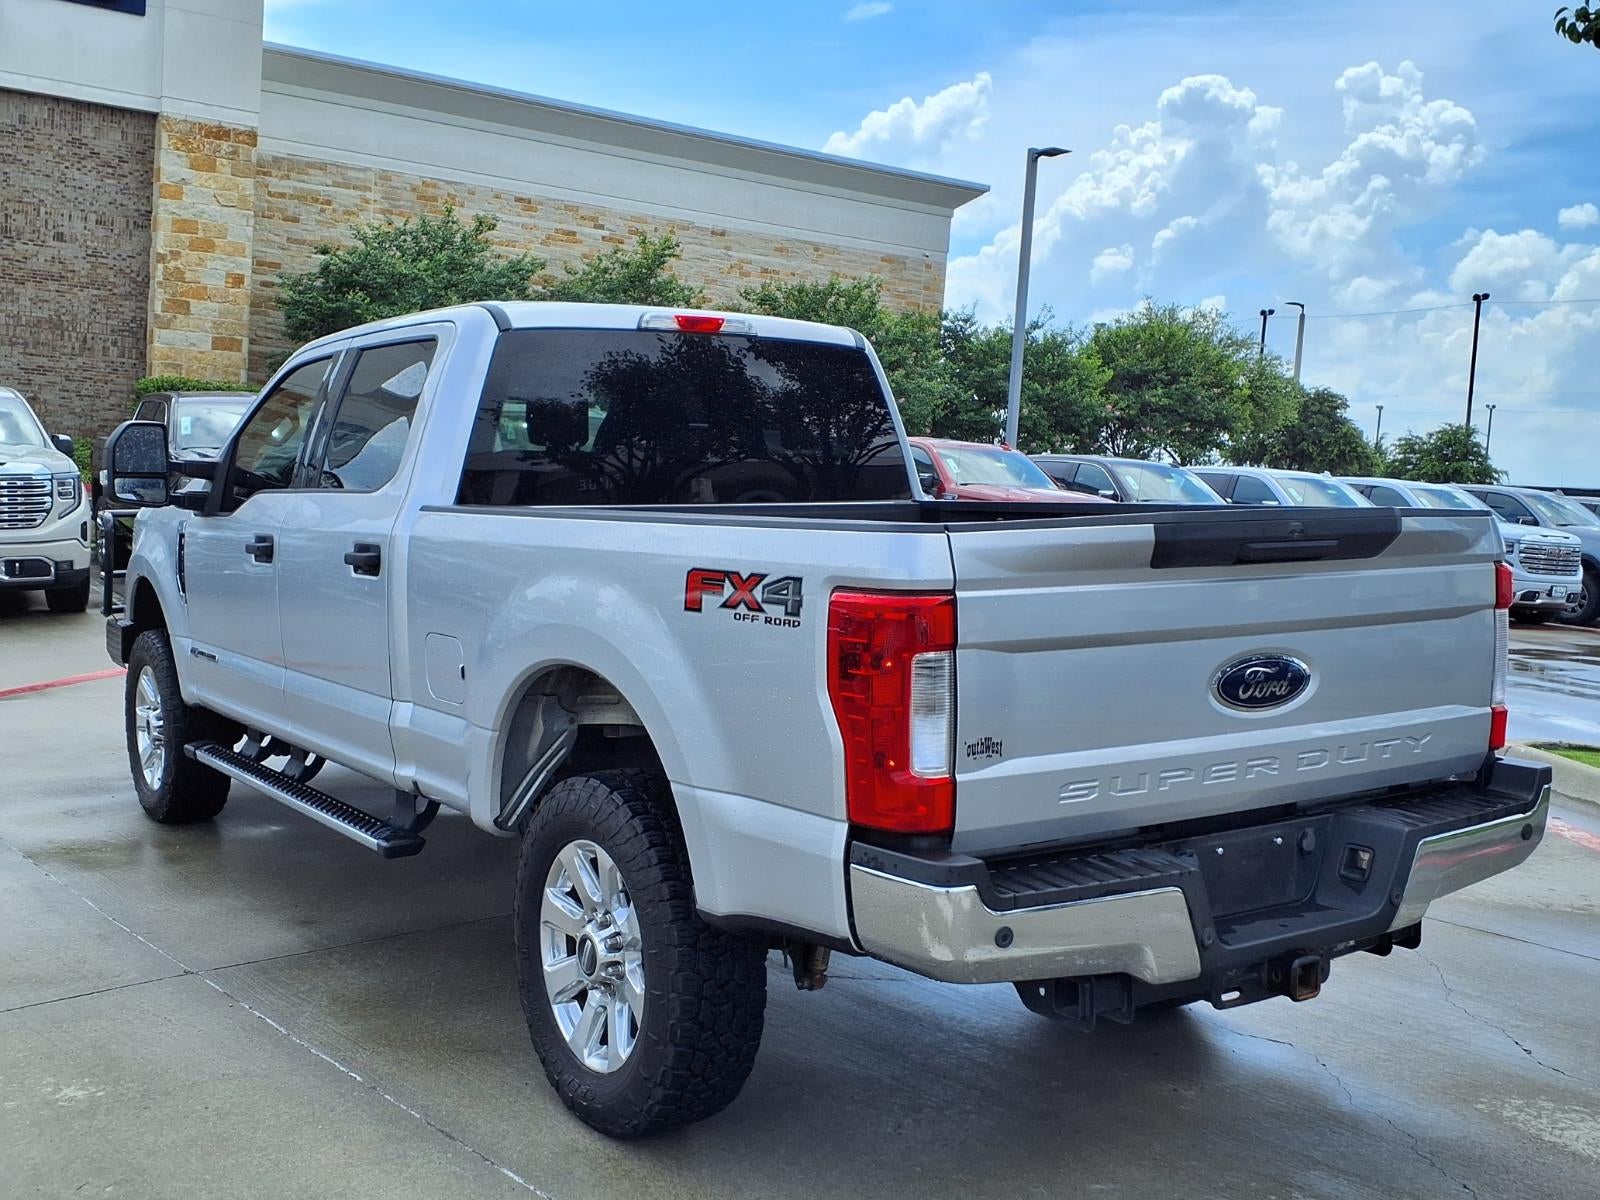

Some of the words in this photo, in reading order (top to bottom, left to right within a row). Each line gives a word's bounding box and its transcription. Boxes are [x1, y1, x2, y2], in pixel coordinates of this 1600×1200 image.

[684, 567, 803, 618] FX4
[733, 612, 760, 624] OFF
[764, 616, 801, 629] ROAD
[1238, 666, 1292, 699] Ford
[964, 736, 1003, 758] outhWest
[1058, 755, 1280, 804] SUPER
[1296, 733, 1433, 772] DUTY
